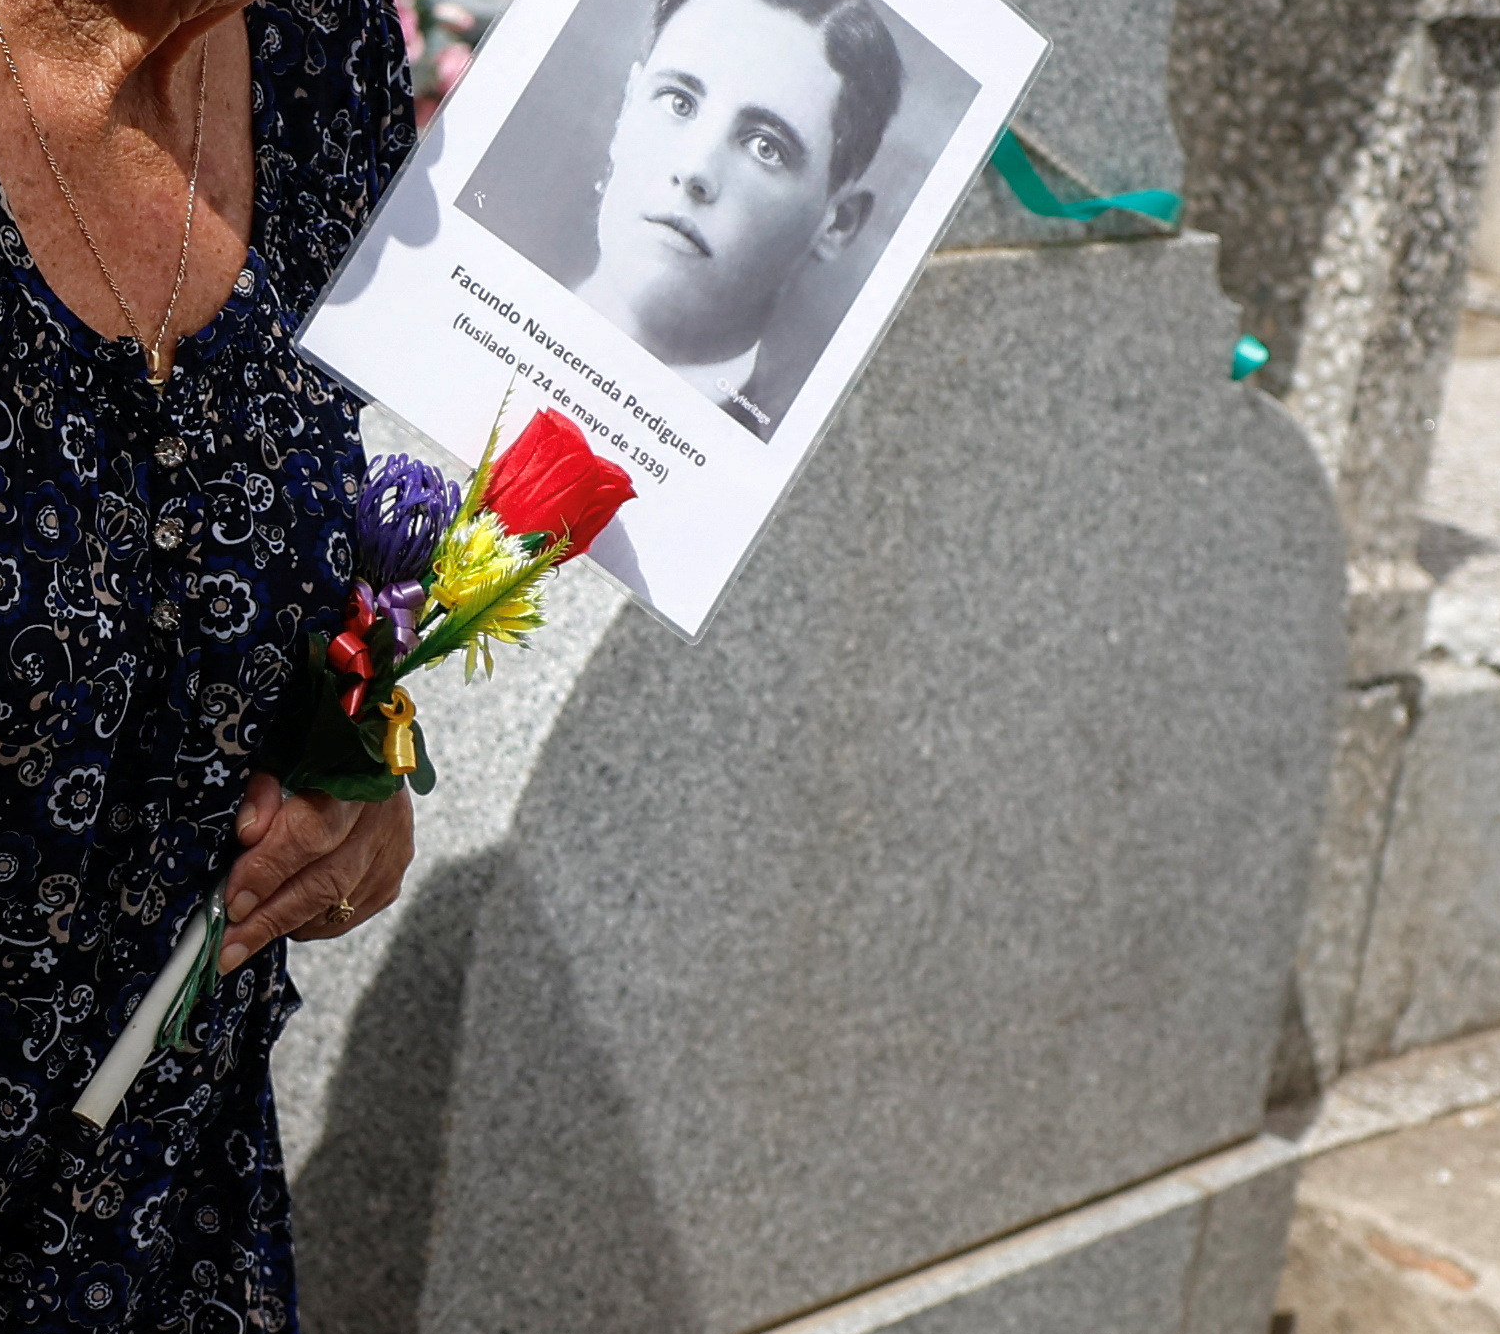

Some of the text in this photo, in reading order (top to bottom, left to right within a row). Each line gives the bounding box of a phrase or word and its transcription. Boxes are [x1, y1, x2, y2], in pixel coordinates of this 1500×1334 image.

[450, 264, 706, 468] Facundo Navacerrada Perdiguero
[453, 312, 670, 485] (fusilado el 24 de mayo de 1939)
[727, 387, 771, 426] MyHeritage
